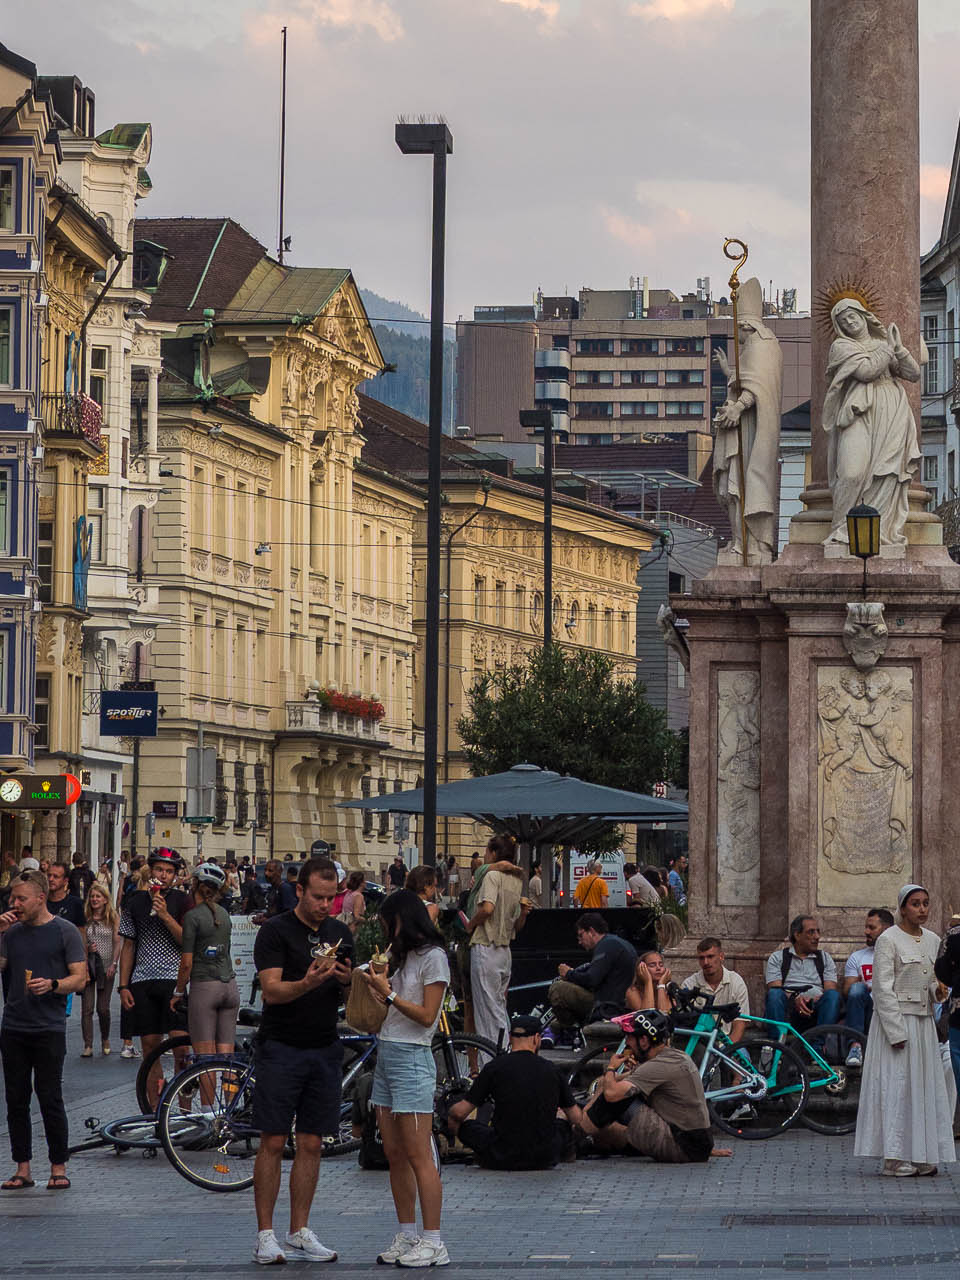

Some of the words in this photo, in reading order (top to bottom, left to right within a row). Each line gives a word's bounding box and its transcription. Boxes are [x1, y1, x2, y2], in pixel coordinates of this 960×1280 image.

[106, 707, 152, 718] SPORTLER
[31, 792, 60, 800] ROLEX
[635, 1014, 657, 1036] POC
